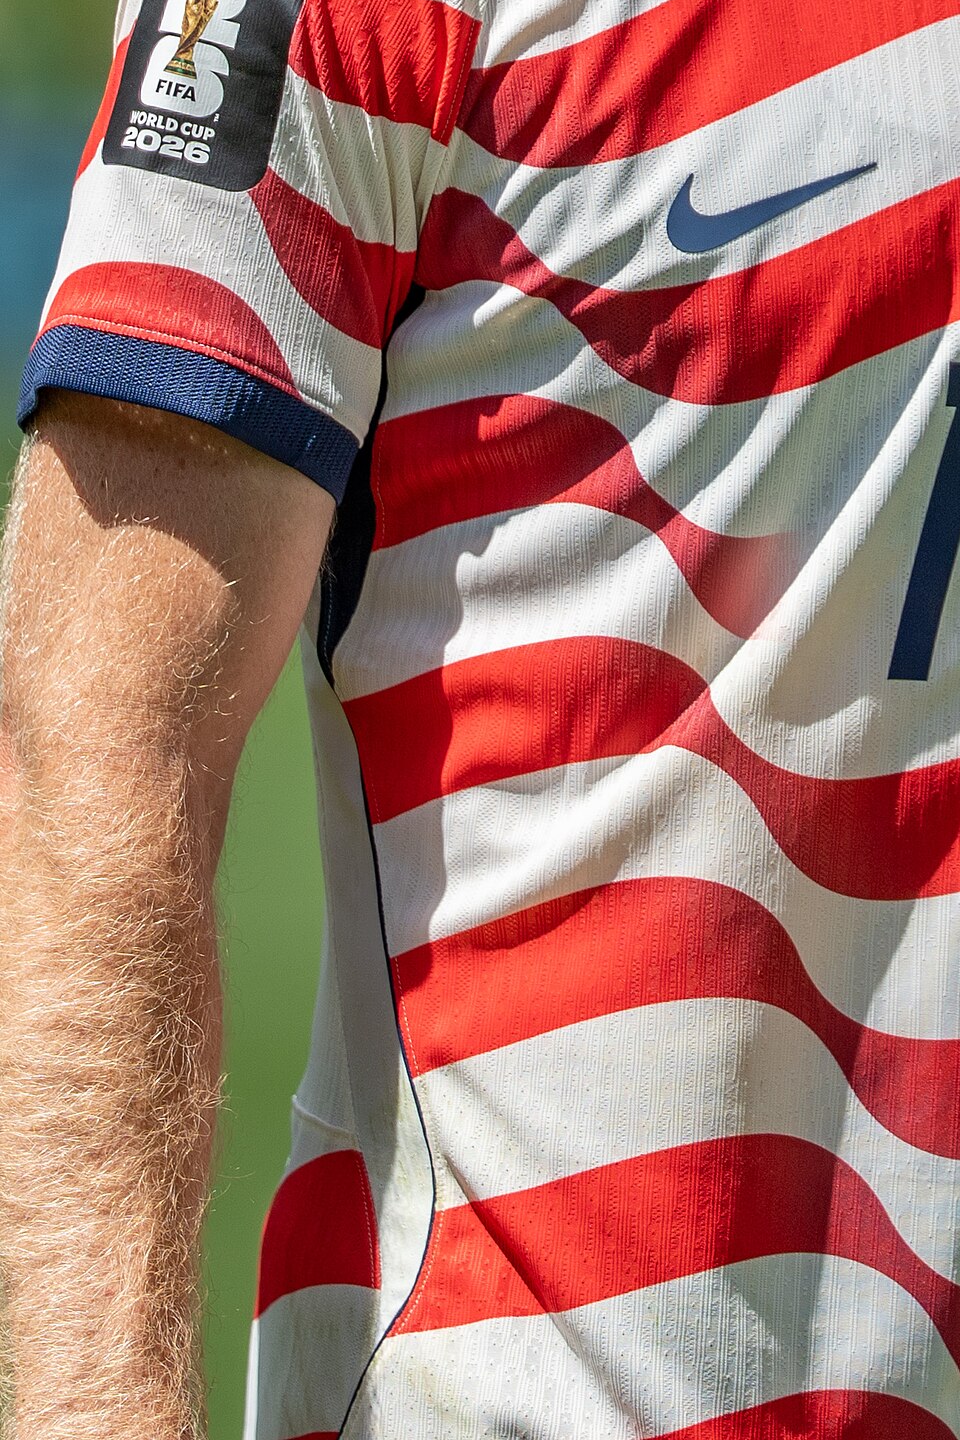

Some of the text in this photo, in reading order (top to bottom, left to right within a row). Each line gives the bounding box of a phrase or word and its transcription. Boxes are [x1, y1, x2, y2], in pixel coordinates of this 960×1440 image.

[155, 78, 197, 102] FIFA
[129, 110, 216, 141] WORLD CUP
[120, 125, 211, 164] 2026
